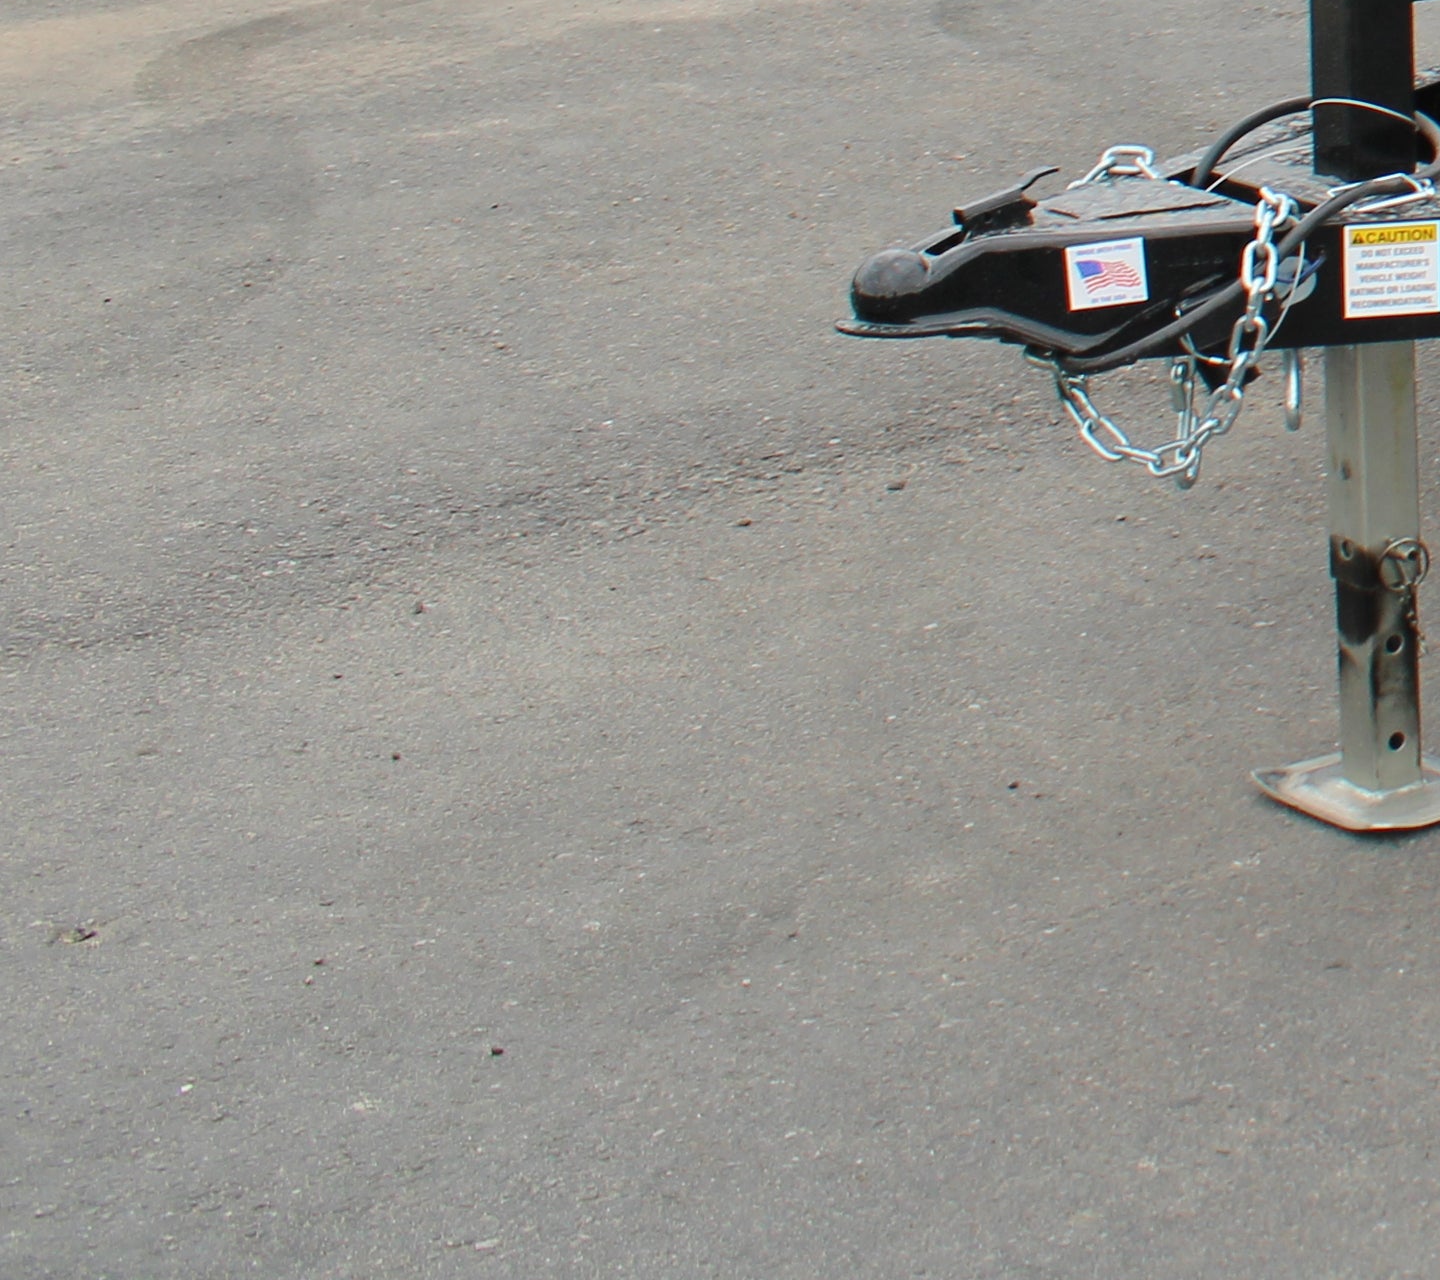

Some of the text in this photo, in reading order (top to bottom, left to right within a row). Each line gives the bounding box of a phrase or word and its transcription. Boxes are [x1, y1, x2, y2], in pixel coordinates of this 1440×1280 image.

[1365, 228, 1434, 244] CAUTION
[1375, 248, 1392, 257] NOT
[1393, 246, 1425, 256] EXCEED
